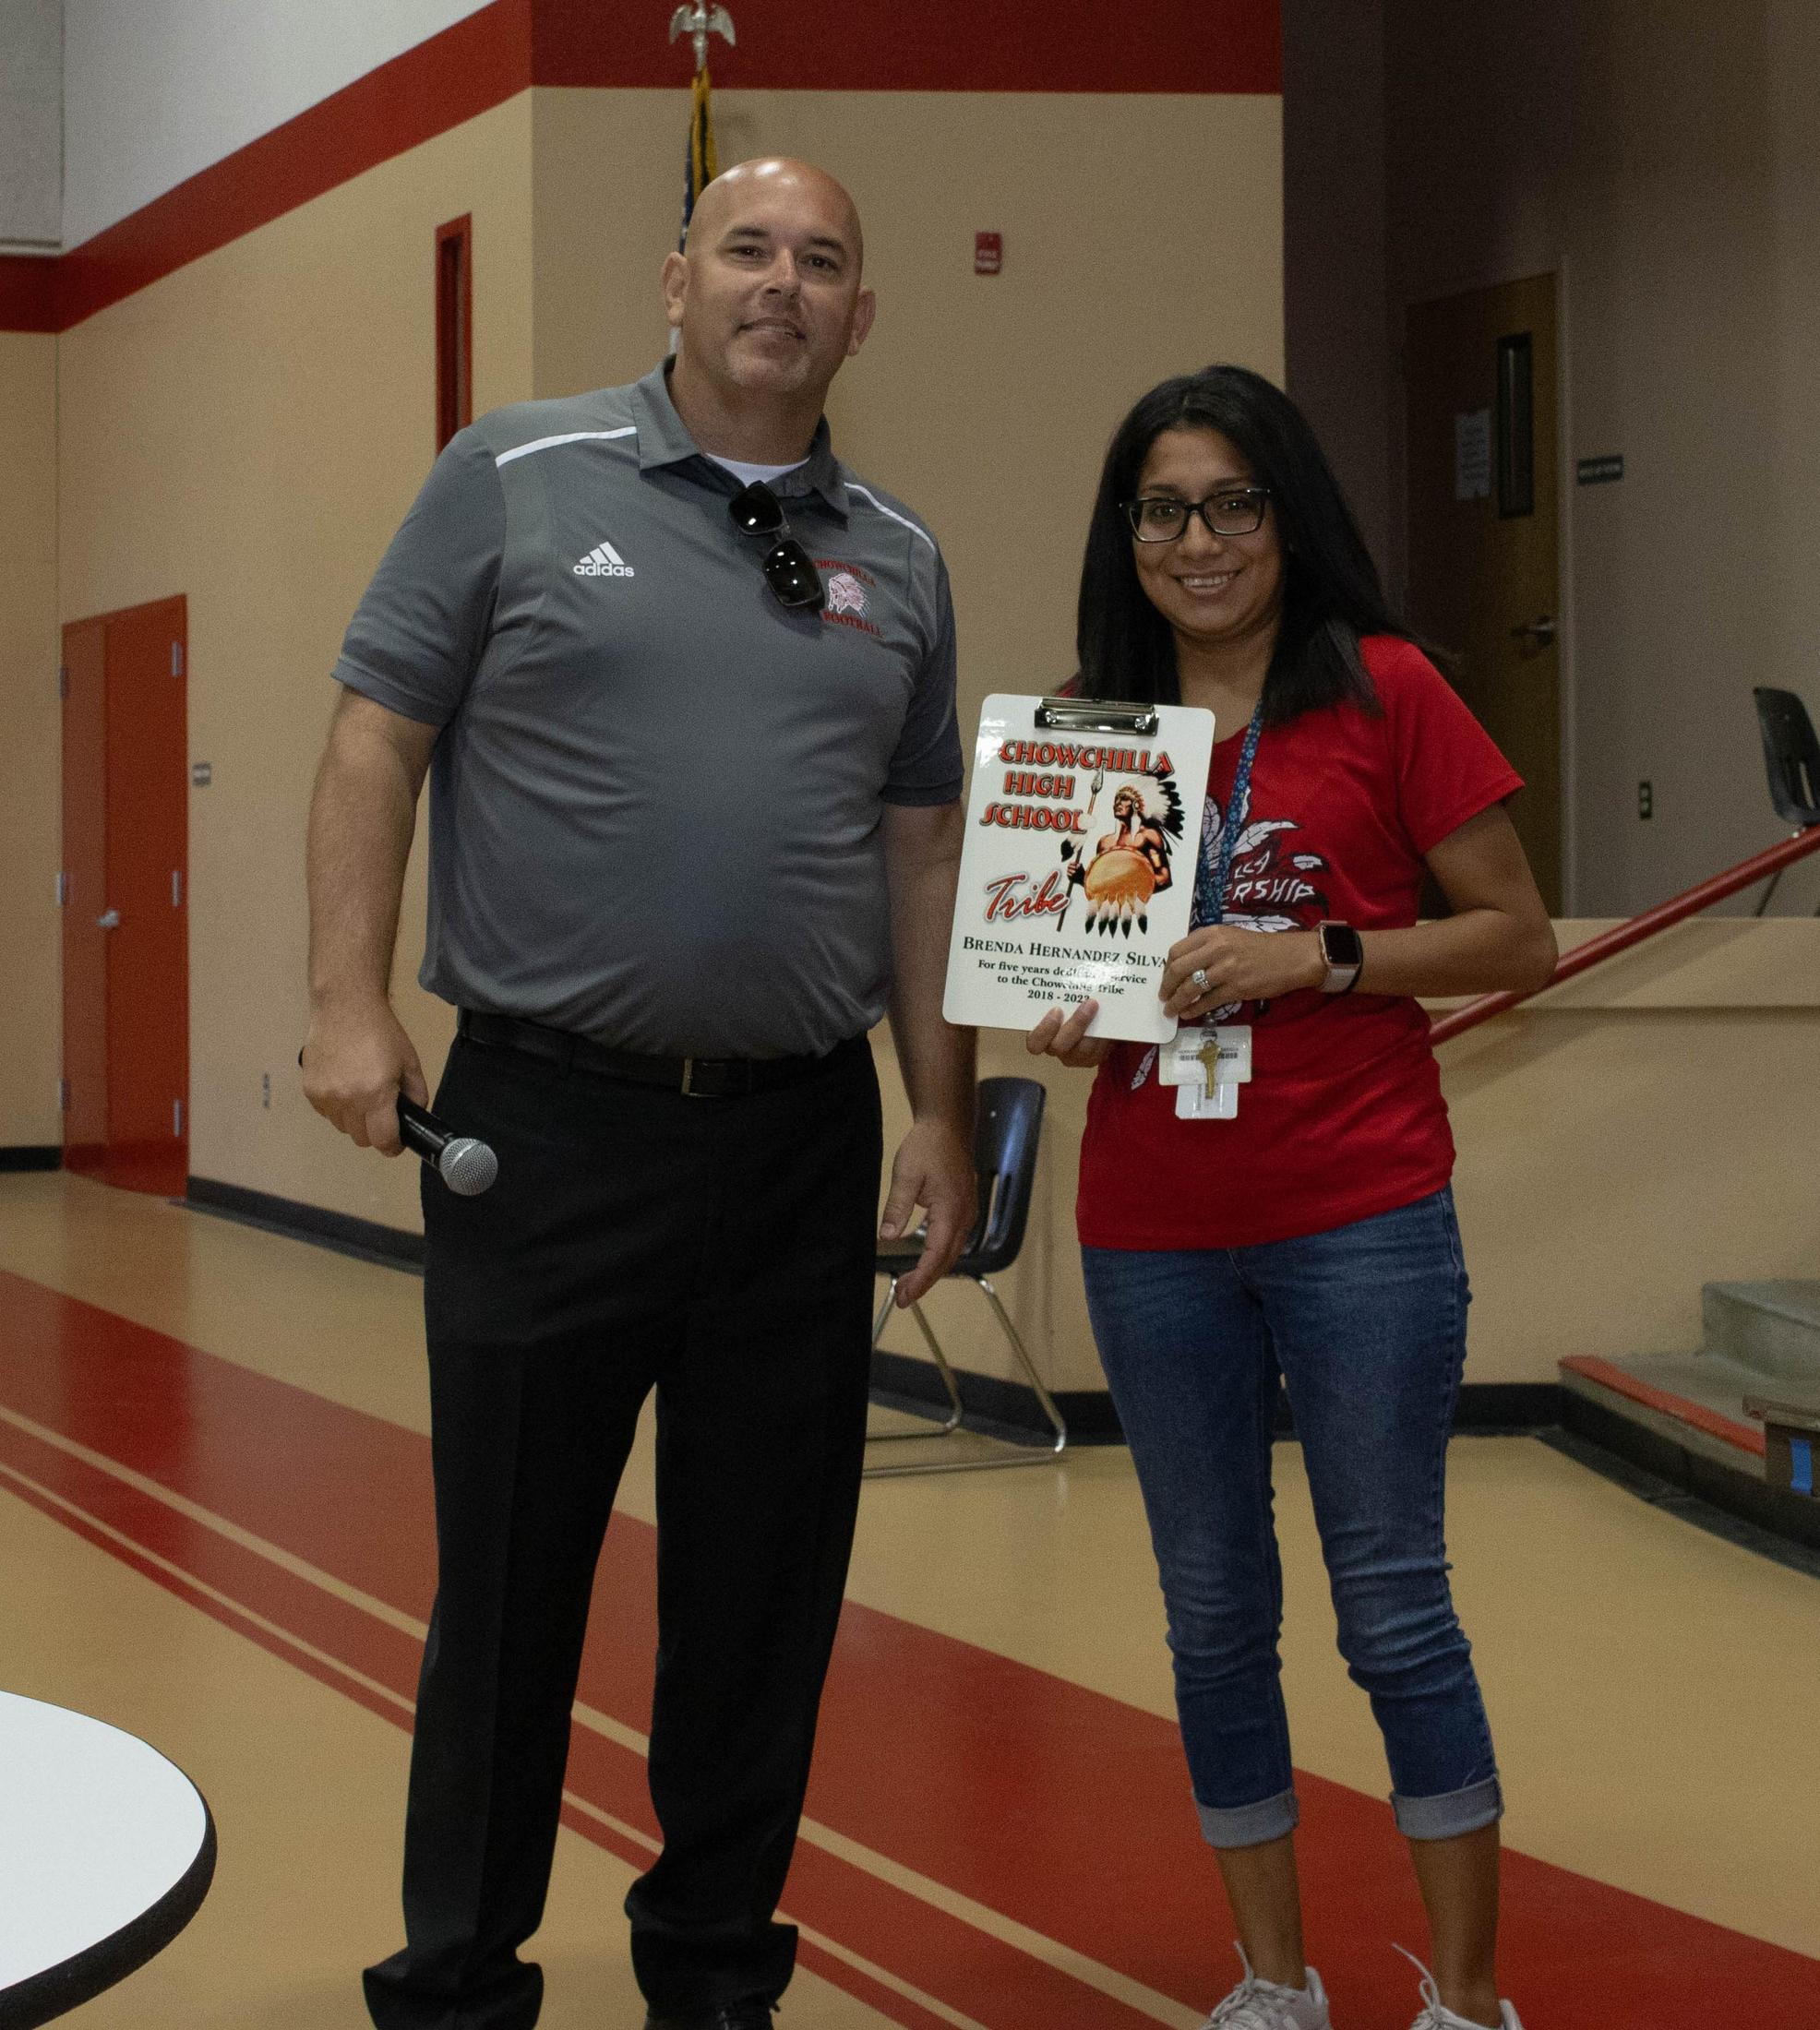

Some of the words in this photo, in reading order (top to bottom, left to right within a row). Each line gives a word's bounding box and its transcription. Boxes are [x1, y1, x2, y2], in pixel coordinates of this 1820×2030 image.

[573, 562, 635, 578] adidas
[820, 609, 882, 637] FOOTBALL
[998, 739, 1175, 776] CHOWCHILLA
[1003, 770, 1074, 800] HIGH
[979, 801, 1088, 834] SCHOOL
[984, 870, 1071, 923] Tribe
[963, 936, 1024, 955] BRENDA
[1029, 942, 1120, 963] HERNANDEZ
[978, 959, 996, 970] For
[999, 961, 1019, 972] five
[1022, 964, 1049, 975] years
[997, 975, 1008, 984] to
[1012, 975, 1029, 985] the
[1027, 989, 1054, 1001] 2018
